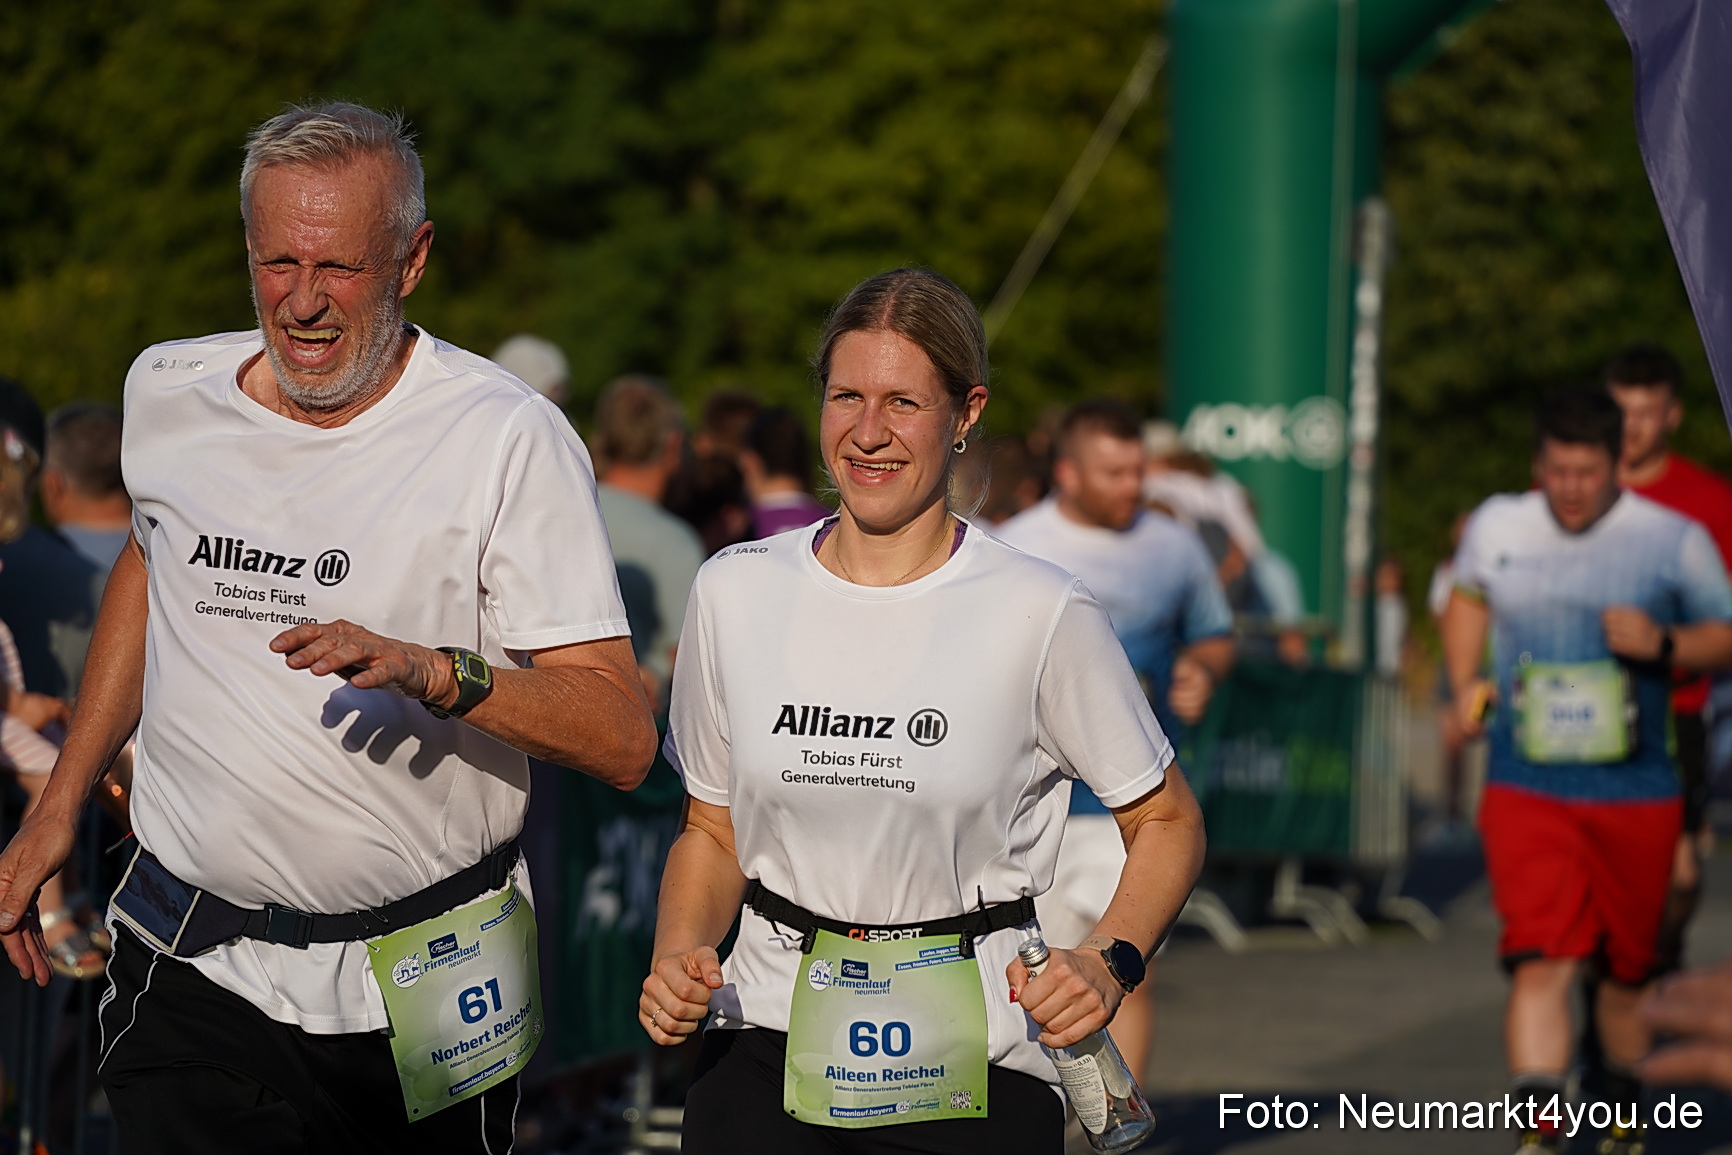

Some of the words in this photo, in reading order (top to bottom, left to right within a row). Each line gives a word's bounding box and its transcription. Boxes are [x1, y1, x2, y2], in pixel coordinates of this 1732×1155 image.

[188, 535, 307, 578] Allianz
[733, 547, 769, 555] JAKO
[214, 582, 266, 601] Tobias
[270, 588, 306, 606] Fürst
[771, 704, 896, 739] Allianz
[801, 750, 855, 766] Tobias
[860, 752, 903, 769] Fürst
[781, 770, 916, 793] Generalvertretung
[424, 940, 480, 973] Firmenlauf
[448, 950, 482, 969] neumarkt
[833, 977, 891, 989] Firmenlauf
[458, 977, 503, 1024] 61
[431, 1030, 492, 1065] Norbert
[493, 997, 532, 1038] Reichel
[849, 1021, 911, 1057] 60
[449, 1058, 467, 1069] Allianz
[825, 1065, 877, 1083] Aileen
[882, 1065, 945, 1082] Reichel
[451, 1062, 505, 1094] firmenlauf.bayern
[834, 1084, 852, 1092] Allianz
[852, 1085, 902, 1093] Generalvertretung
[832, 1106, 894, 1117] firmenlauf.bayern
